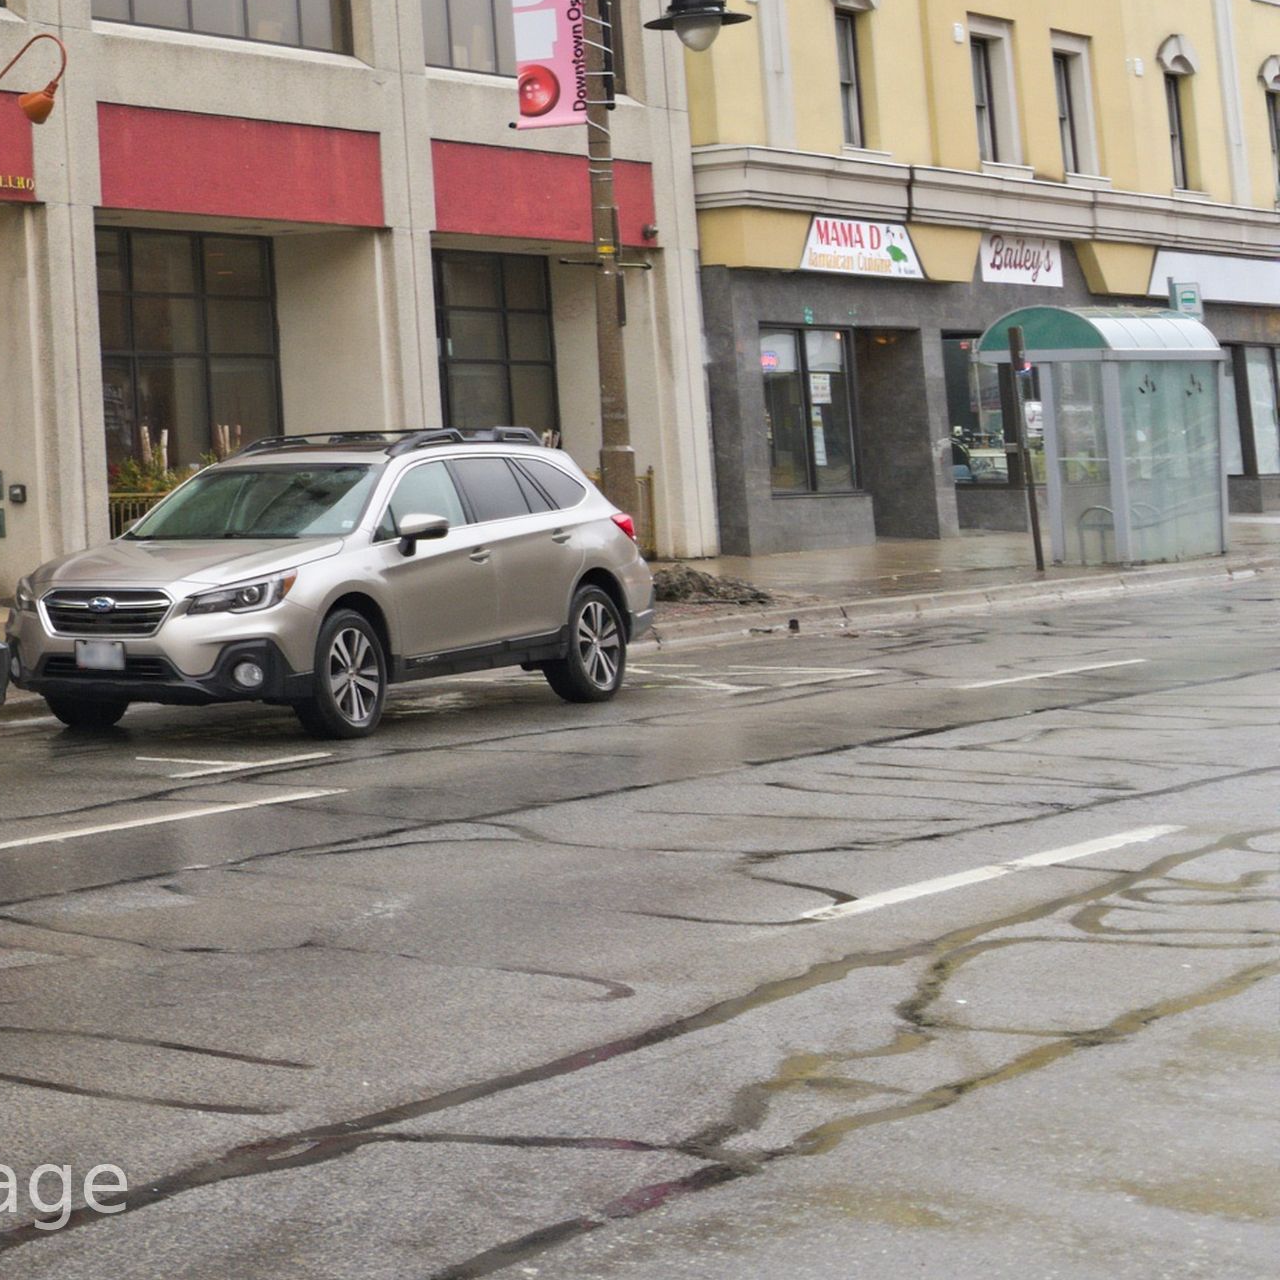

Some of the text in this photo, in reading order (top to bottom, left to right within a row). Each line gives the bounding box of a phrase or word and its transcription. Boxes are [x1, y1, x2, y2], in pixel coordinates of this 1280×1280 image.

[571, 23, 587, 112] Downtown
[815, 219, 881, 250] MAMA D
[990, 235, 1053, 282] Bailey's
